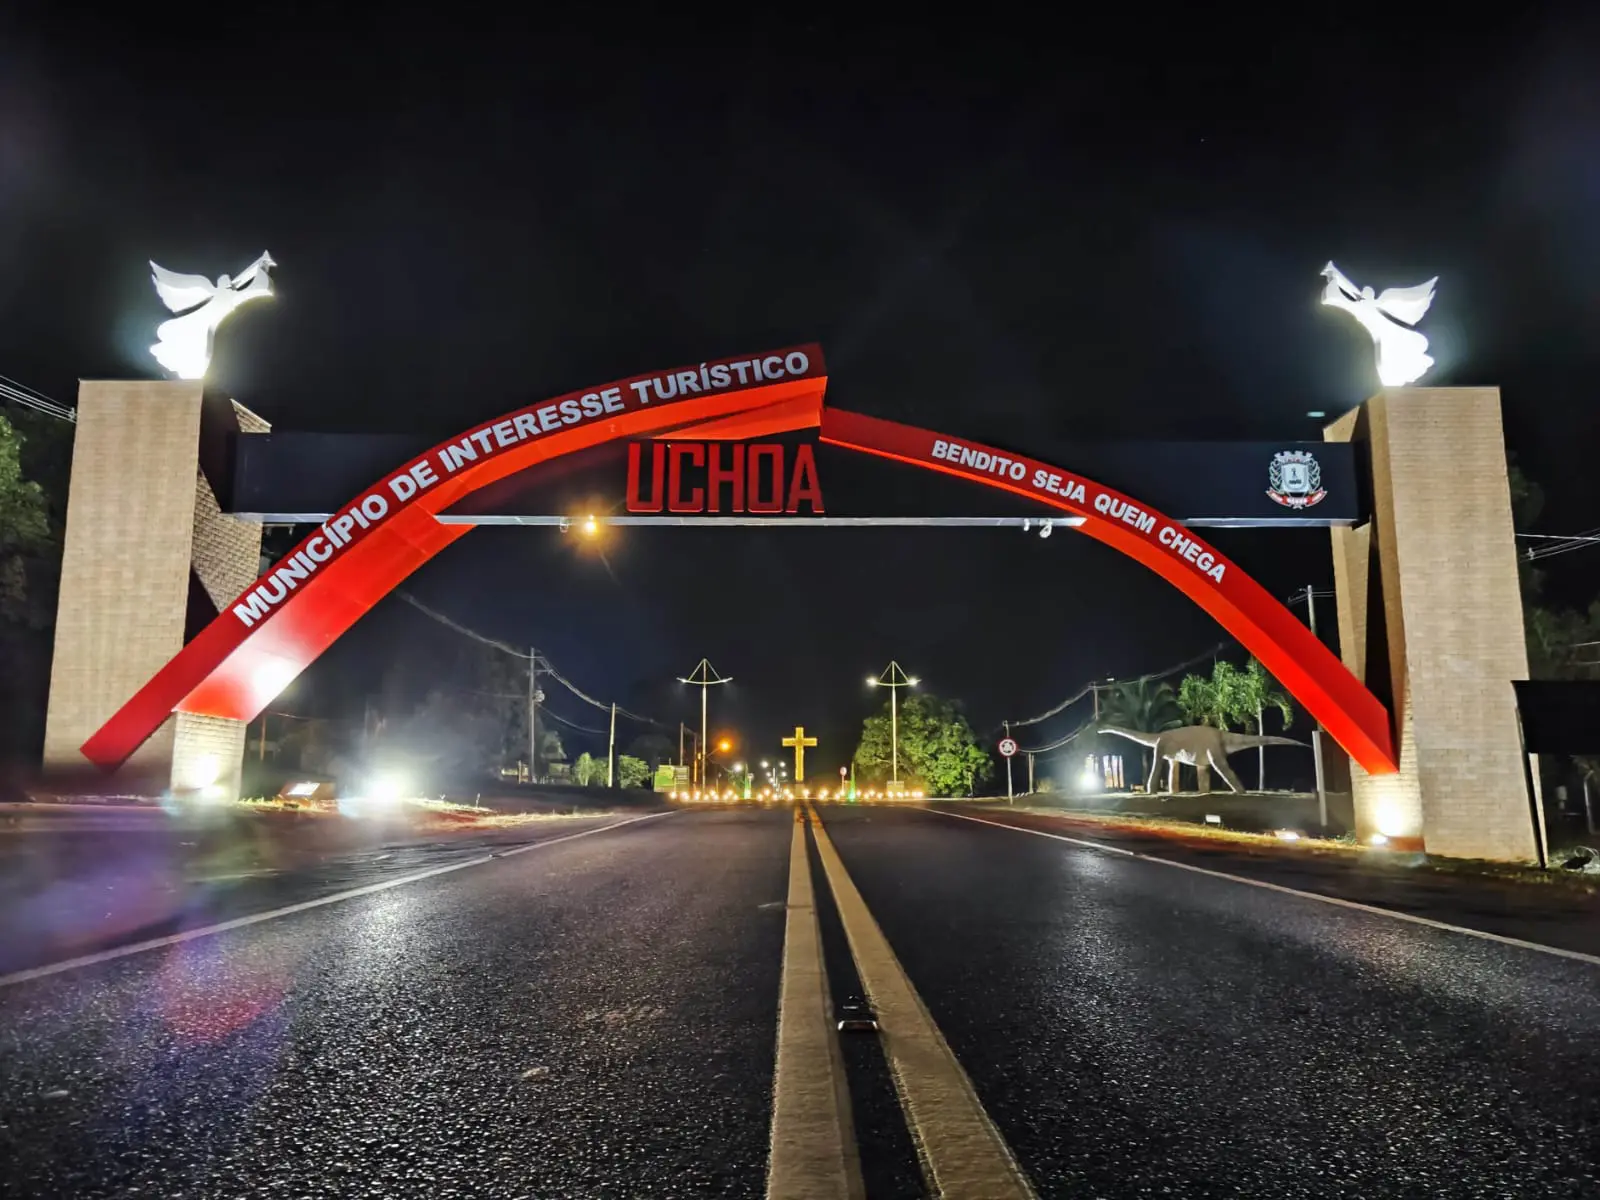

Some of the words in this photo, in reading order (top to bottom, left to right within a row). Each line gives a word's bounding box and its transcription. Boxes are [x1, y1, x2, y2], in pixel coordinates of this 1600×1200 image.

[232, 493, 389, 628] MUNICÍPIO
[388, 460, 439, 502] DE
[438, 387, 624, 472] INTERESSE
[630, 351, 809, 404] TURÍSTICO
[626, 443, 825, 513] UCHOA
[931, 440, 1026, 480] BENDITO
[1032, 469, 1086, 504] SEJA
[1094, 494, 1156, 534] QUEM
[1158, 526, 1226, 583] CHEGA
